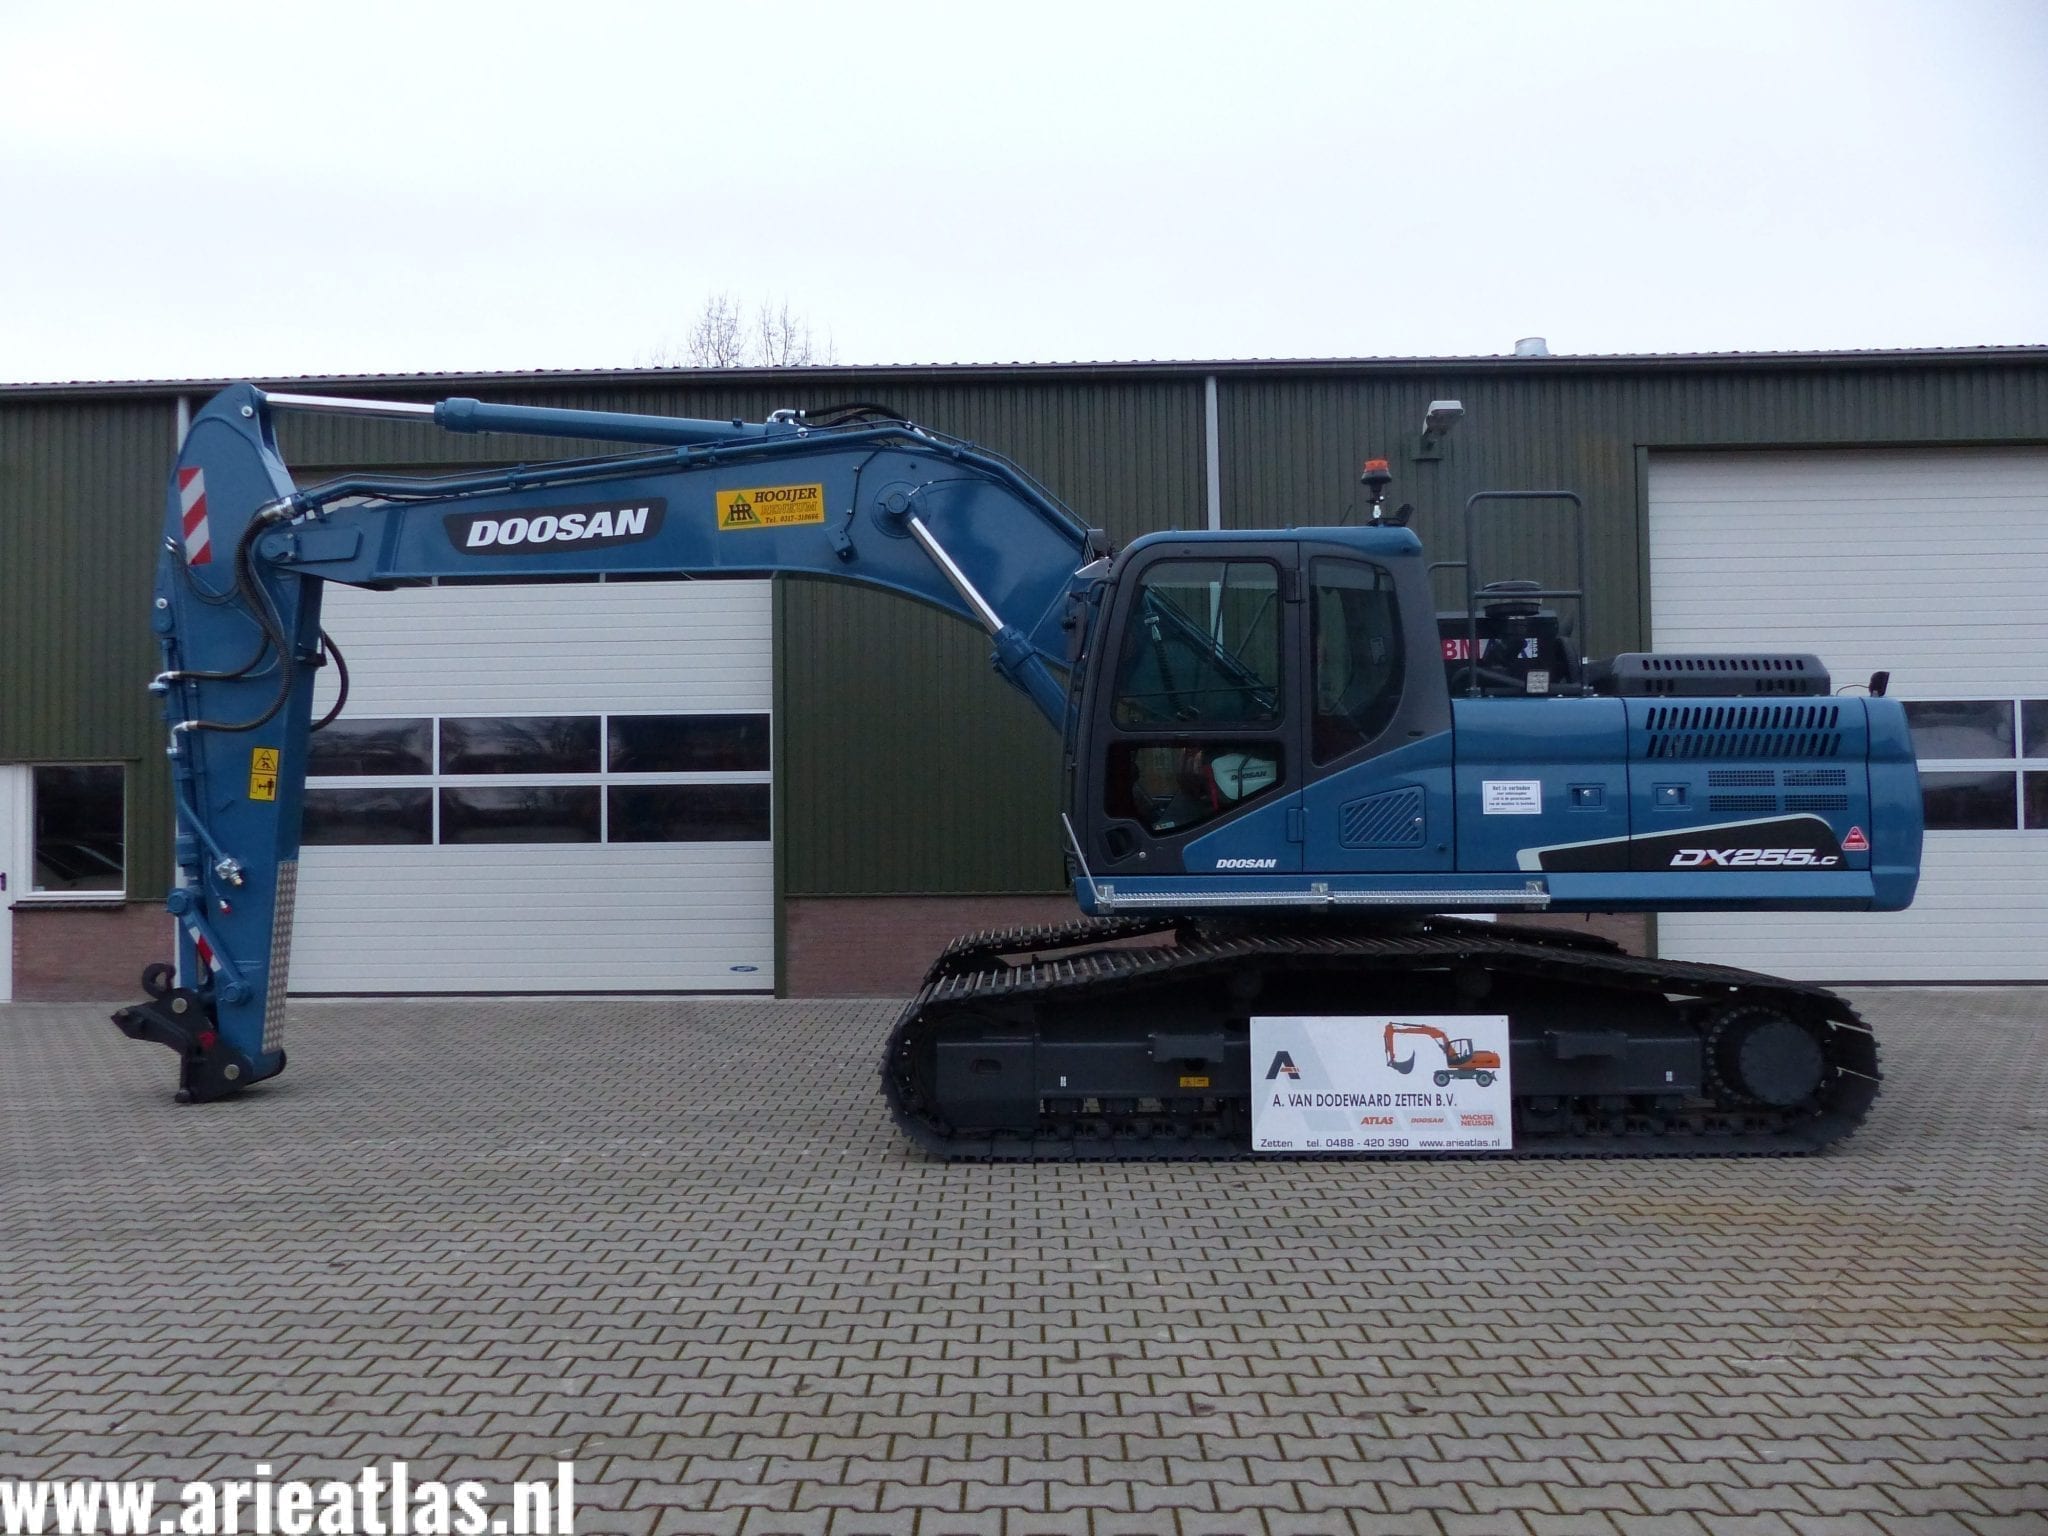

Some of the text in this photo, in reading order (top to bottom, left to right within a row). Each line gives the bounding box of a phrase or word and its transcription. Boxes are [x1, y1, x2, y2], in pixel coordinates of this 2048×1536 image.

[754, 487, 817, 503] HOOIJER
[466, 507, 649, 547] DOOSAN
[1231, 770, 1267, 781] DOSAN
[1216, 859, 1277, 869] DOOSAN
[1272, 1093, 1457, 1107] A. VAN DODEWAARD ZETTEN B.V.
[1361, 1116, 1394, 1125] ATLAS
[1260, 1138, 1293, 1147] Zetten
[1326, 1138, 1354, 1147] 0488
[1363, 1138, 1385, 1147] 420
[1388, 1138, 1409, 1147] 390
[1419, 1138, 1500, 1147] www.arieatlas.nl
